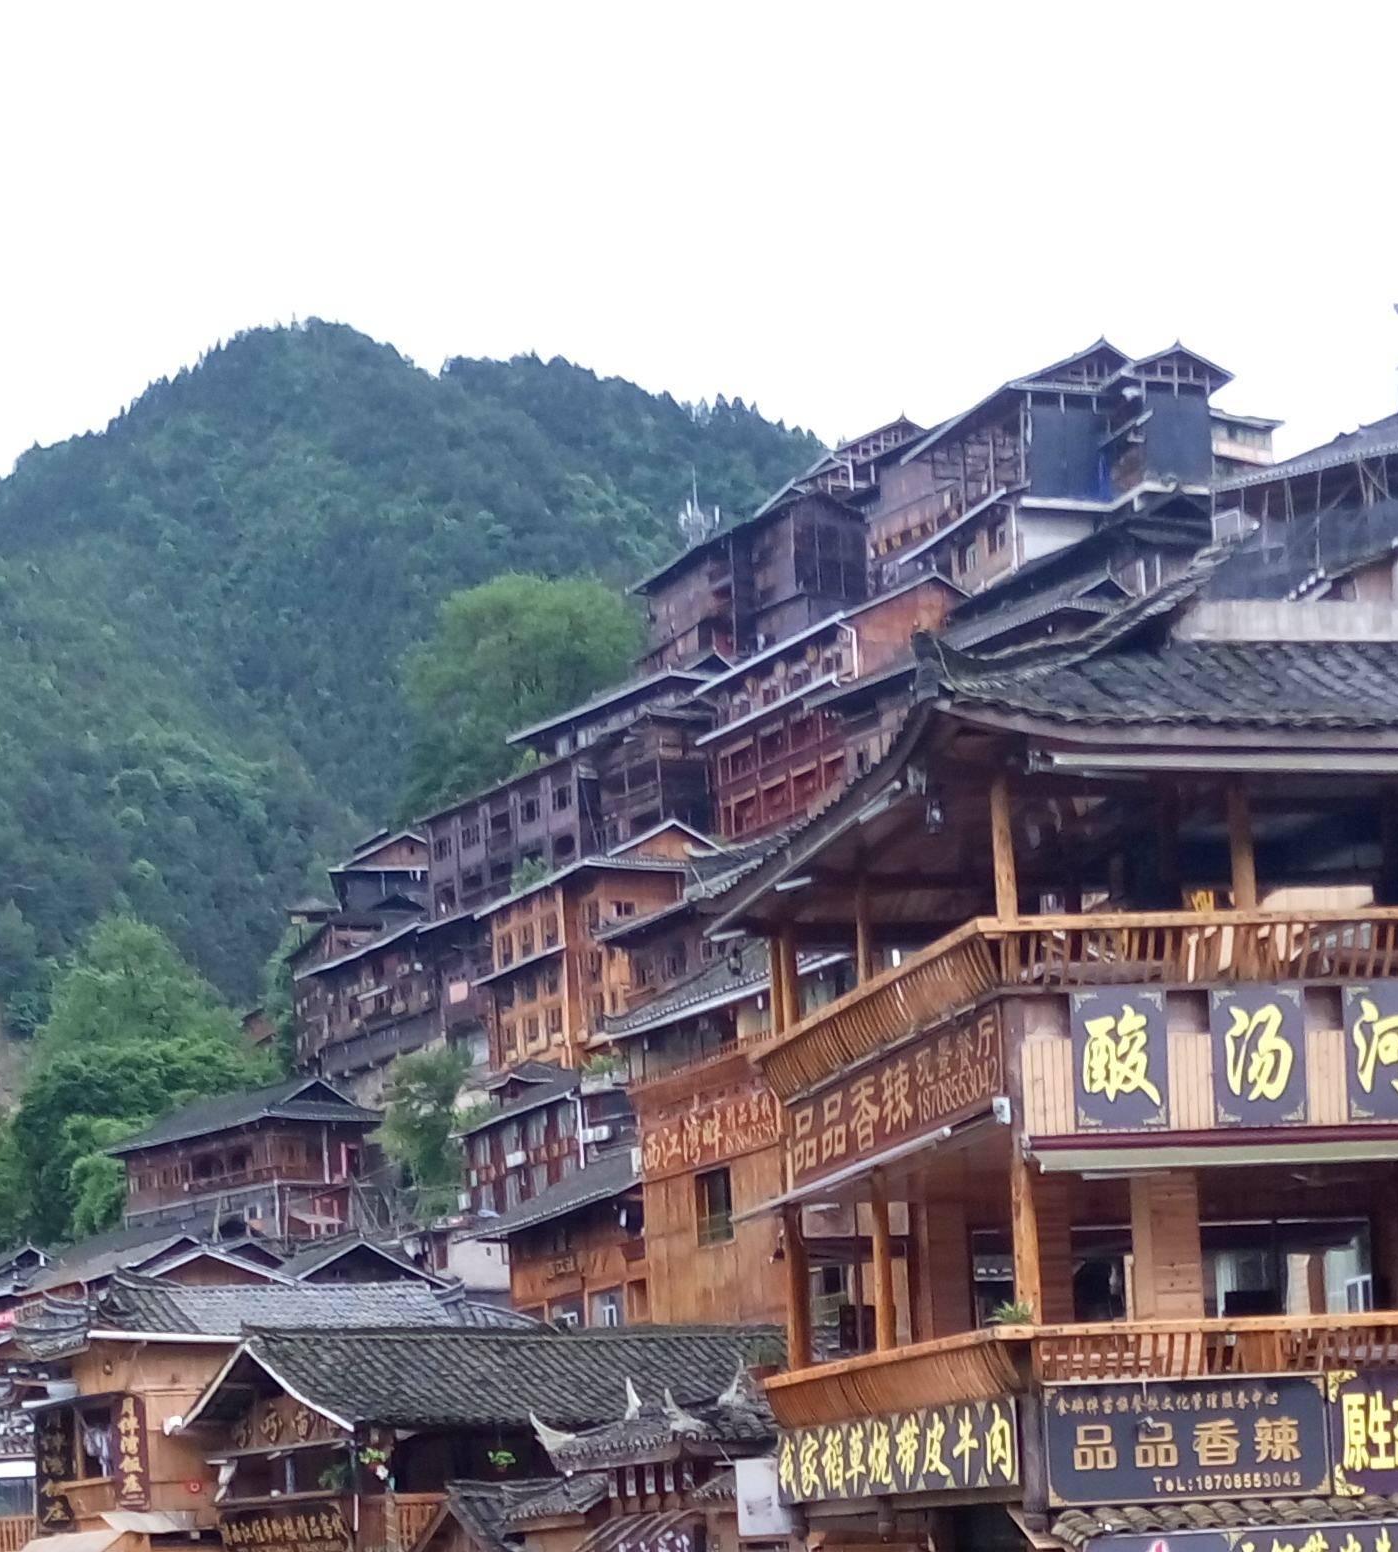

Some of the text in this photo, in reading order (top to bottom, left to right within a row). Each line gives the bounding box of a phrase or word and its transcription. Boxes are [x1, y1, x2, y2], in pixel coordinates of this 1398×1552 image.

[794, 1059, 914, 1176] 品品香辣
[778, 1402, 1017, 1497] 我家稻草烧带皮牛肉
[1073, 1417, 1302, 1471] 品品香辣
